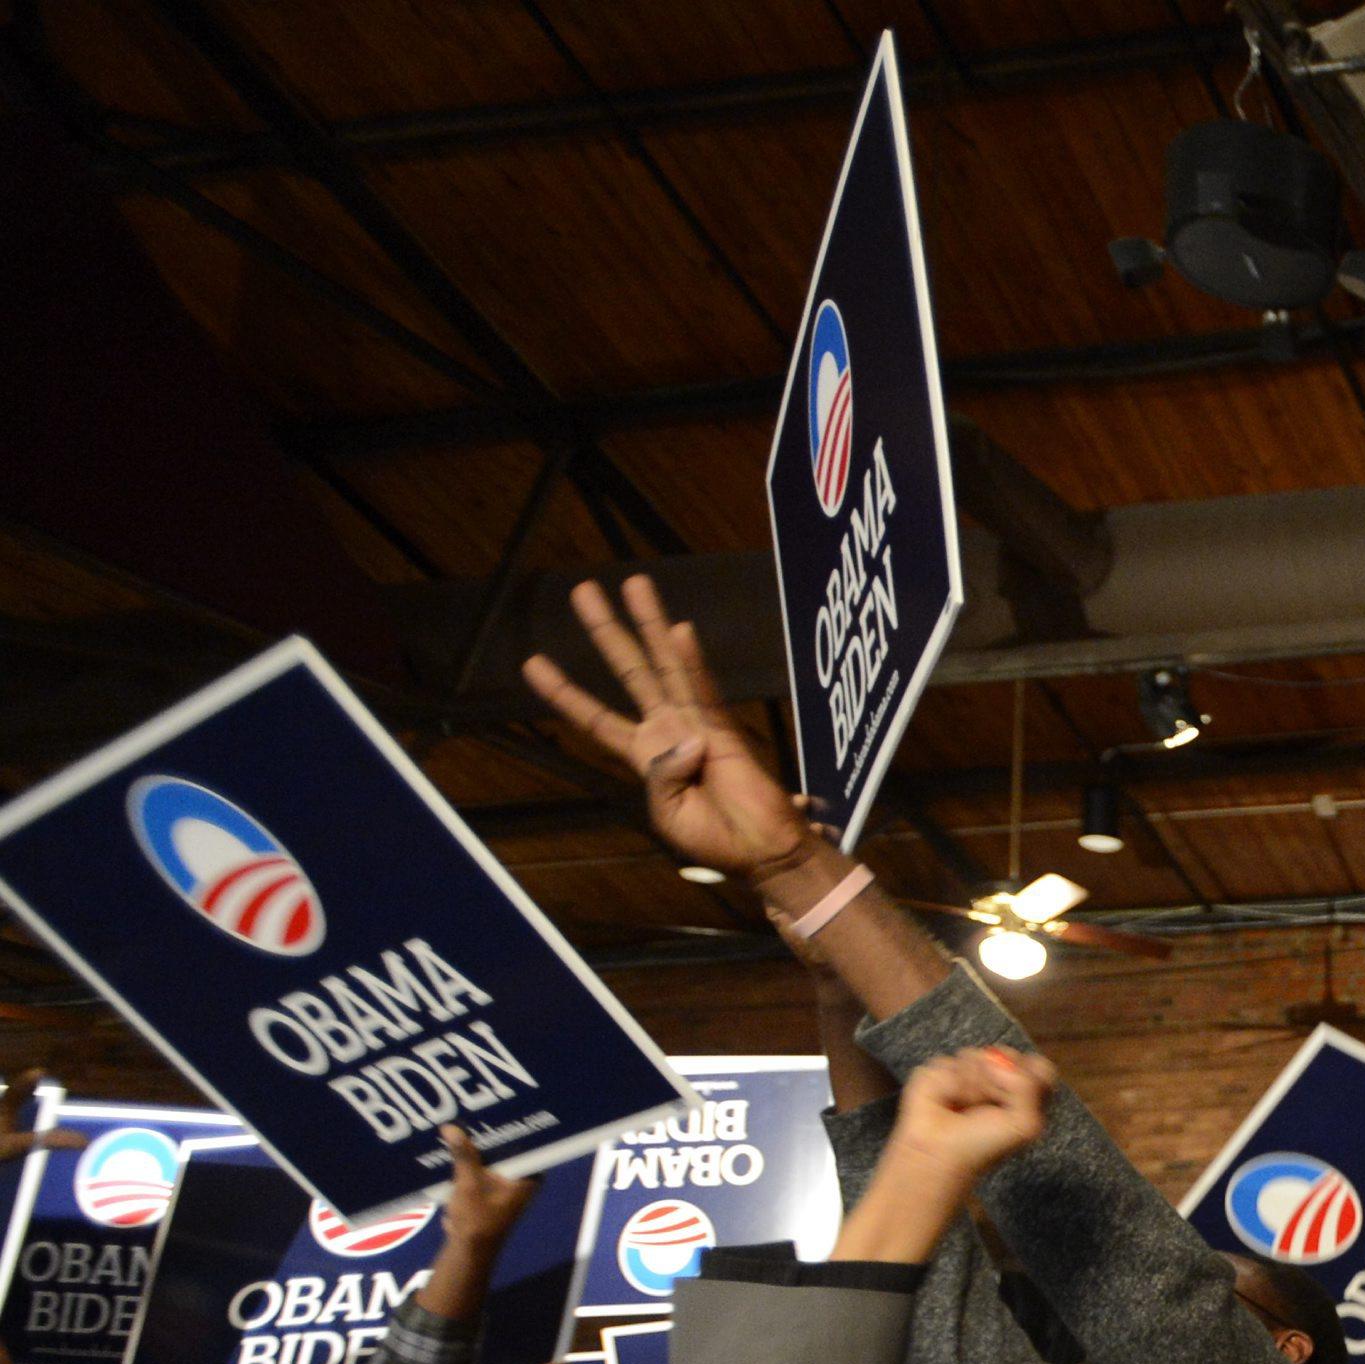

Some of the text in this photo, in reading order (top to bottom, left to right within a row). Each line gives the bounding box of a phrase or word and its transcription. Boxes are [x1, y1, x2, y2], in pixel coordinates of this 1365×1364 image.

[815, 435, 896, 689] OBAMA
[829, 544, 898, 771] BIDEN
[248, 936, 494, 1076] OBAMA
[326, 1019, 540, 1145] BIDEN
[20, 1241, 152, 1288] OBA
[23, 1290, 144, 1337] BIDE
[227, 1268, 436, 1331] OBAM
